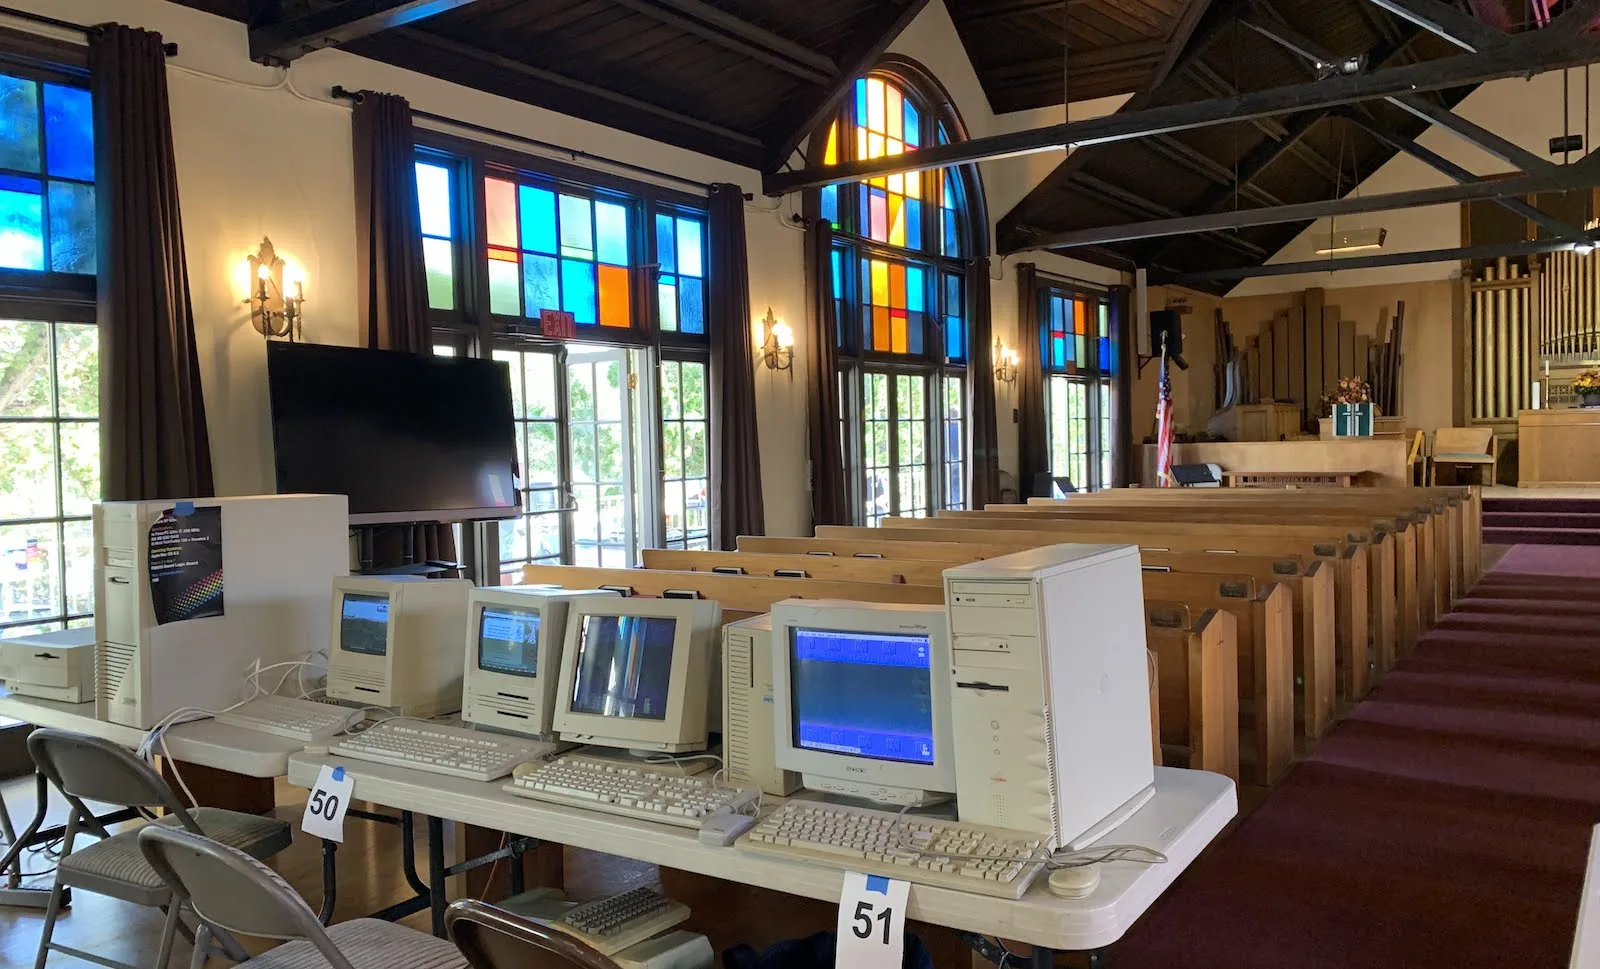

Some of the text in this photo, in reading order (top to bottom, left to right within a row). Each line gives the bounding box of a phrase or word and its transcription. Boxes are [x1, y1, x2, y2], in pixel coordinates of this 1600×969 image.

[543, 311, 573, 337] EXIT
[310, 789, 339, 821] 50
[852, 901, 892, 945] 51
